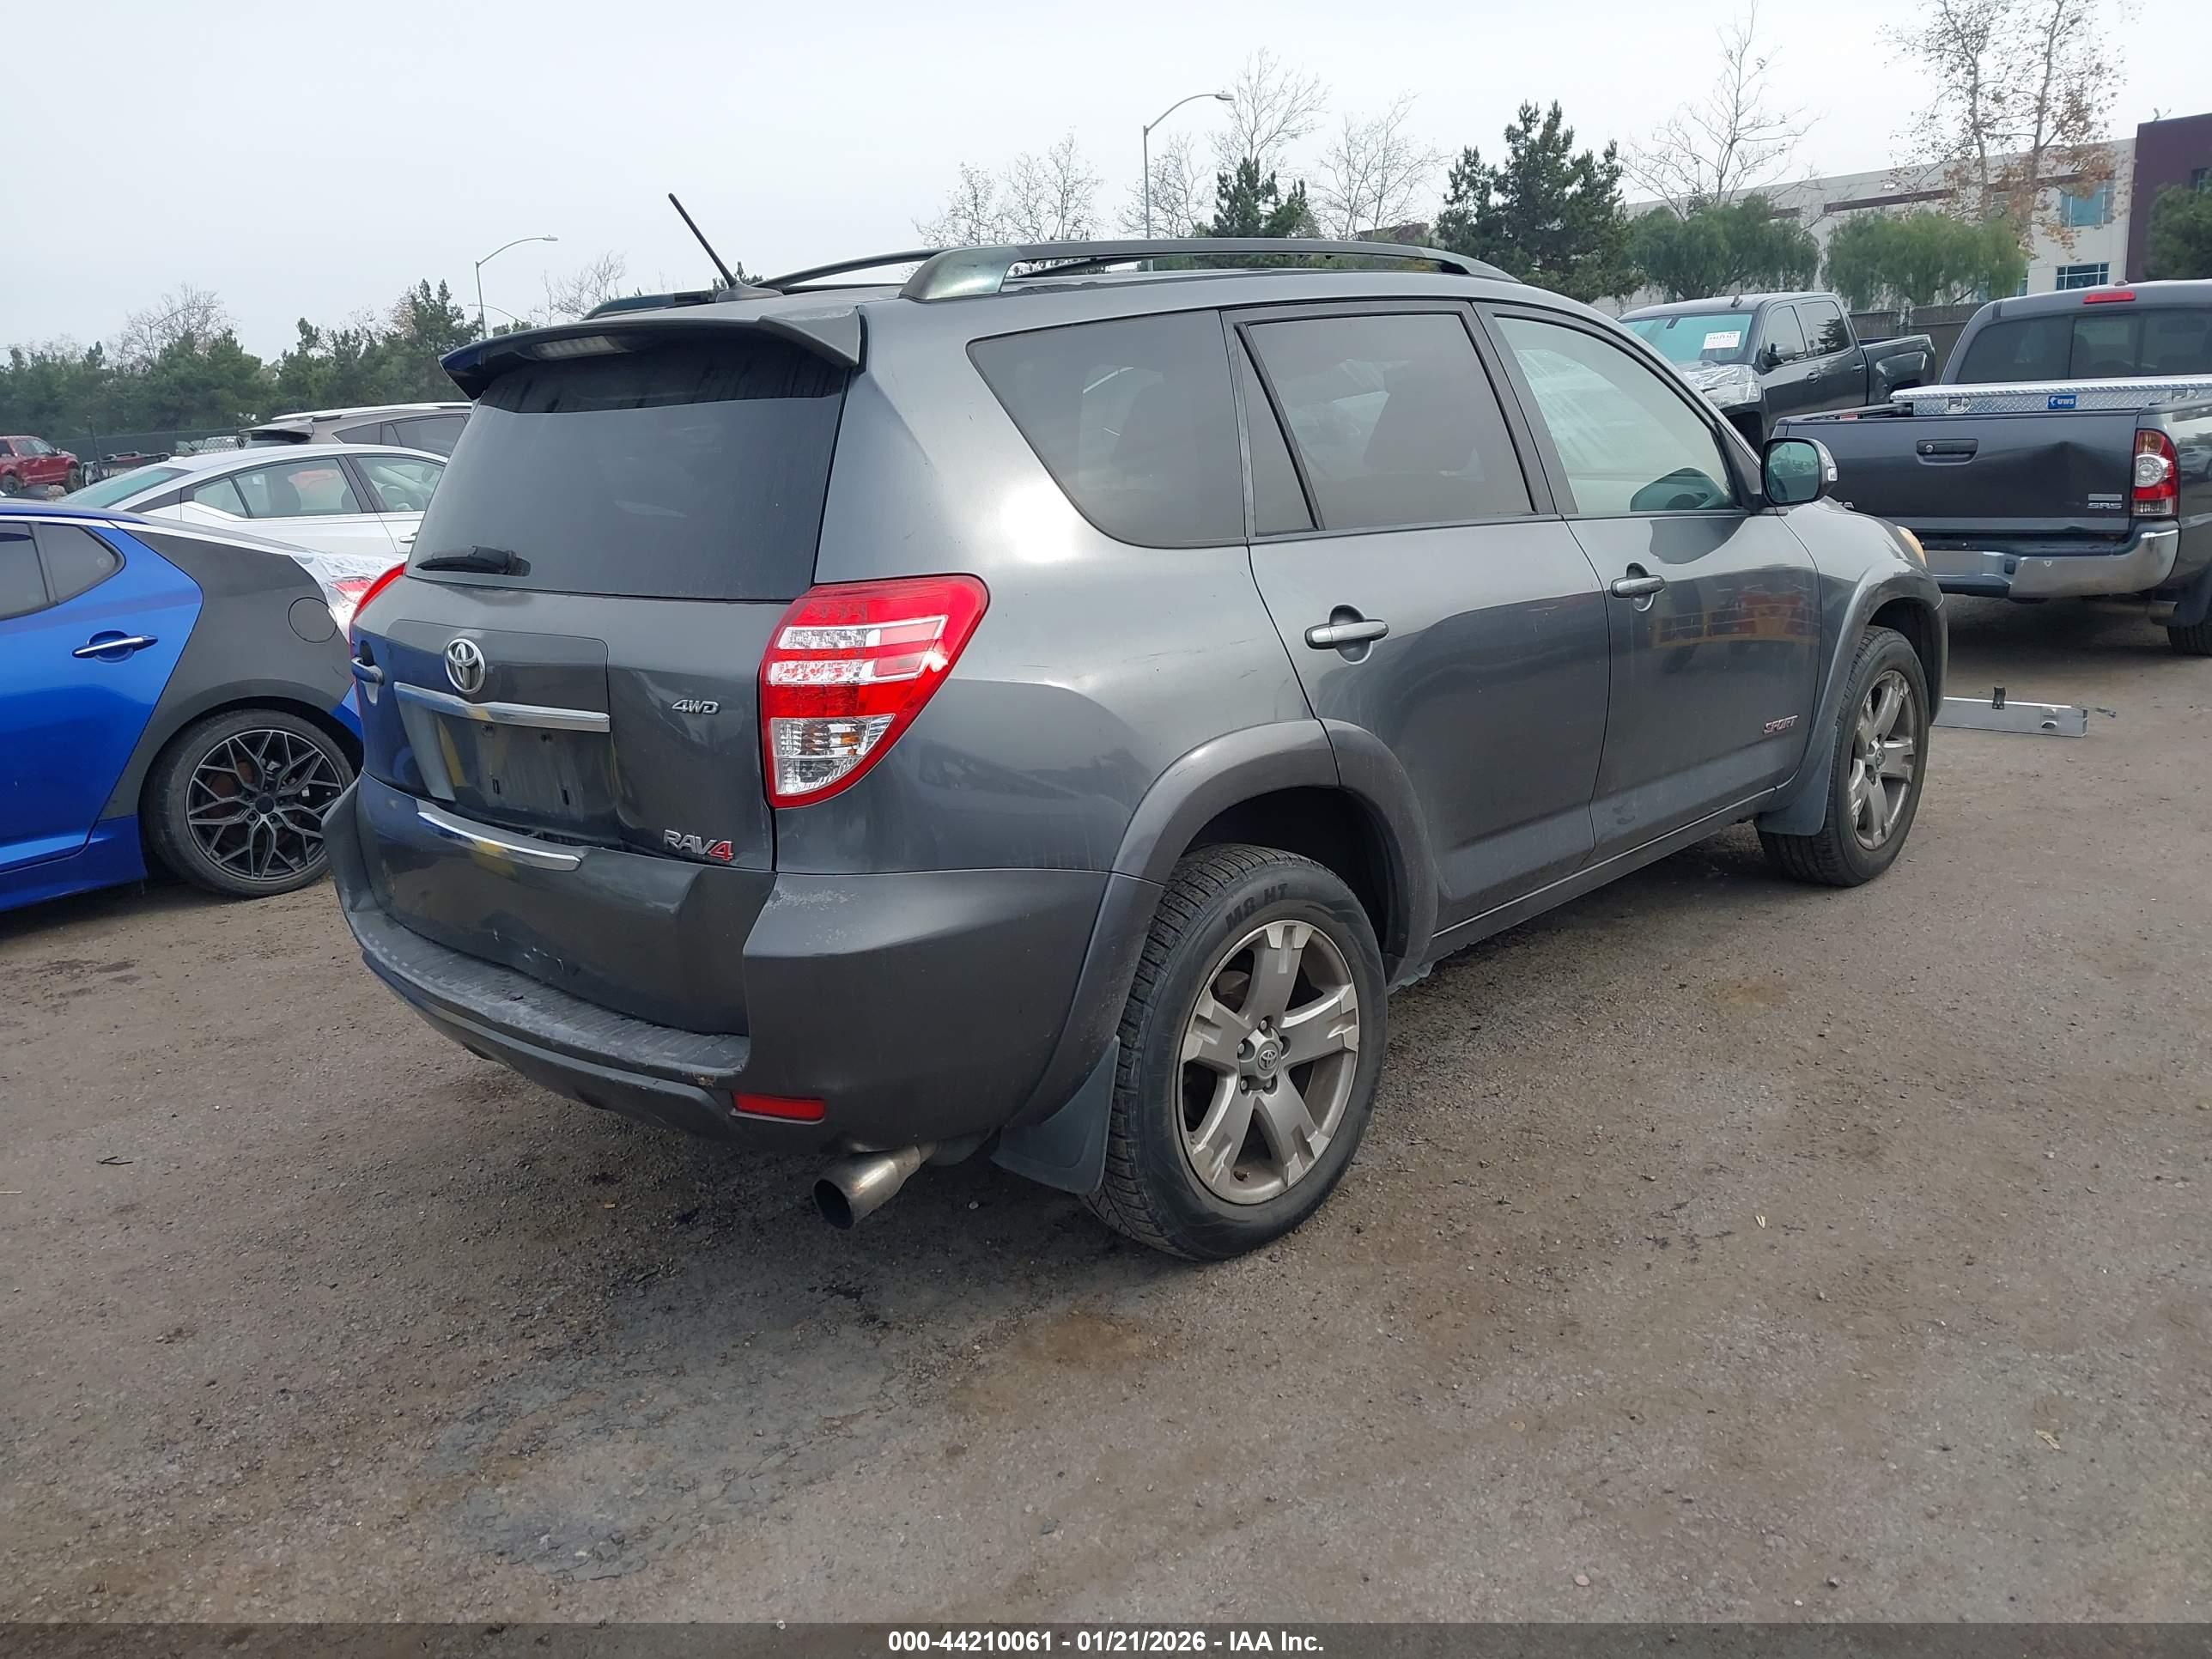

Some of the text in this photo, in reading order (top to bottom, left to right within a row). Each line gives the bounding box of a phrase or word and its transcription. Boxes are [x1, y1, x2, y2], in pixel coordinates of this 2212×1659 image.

[672, 699, 719, 714] 4WD
[1764, 715, 1798, 733] SPORT
[664, 829, 734, 861] RAV4
